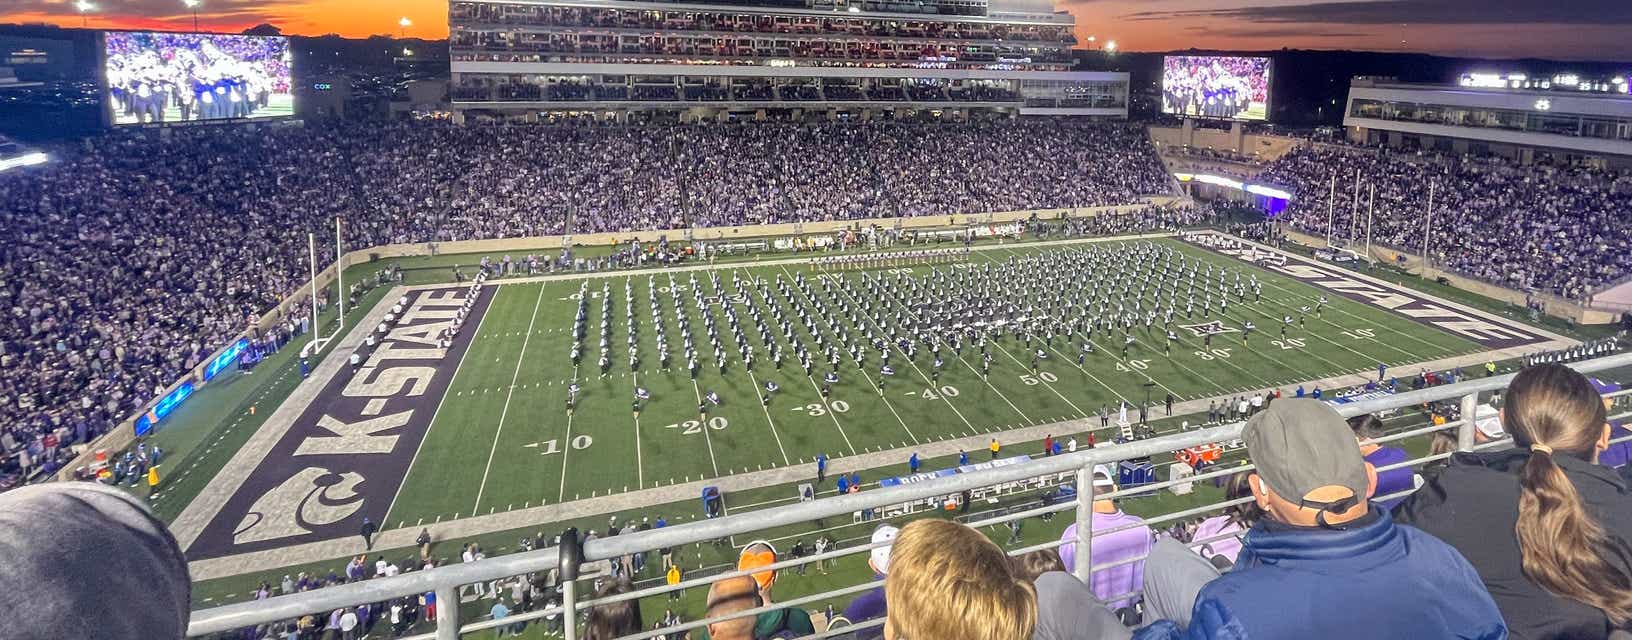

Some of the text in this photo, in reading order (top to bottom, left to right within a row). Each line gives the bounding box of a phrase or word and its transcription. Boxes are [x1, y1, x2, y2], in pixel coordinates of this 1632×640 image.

[1271, 338, 1306, 350] 20
[293, 290, 460, 456] K-STATE
[1115, 359, 1149, 373] 40
[1019, 371, 1058, 386] 50
[921, 385, 960, 401] 40
[806, 400, 850, 416] 30
[681, 416, 728, 435] 20
[540, 435, 593, 456] 10
